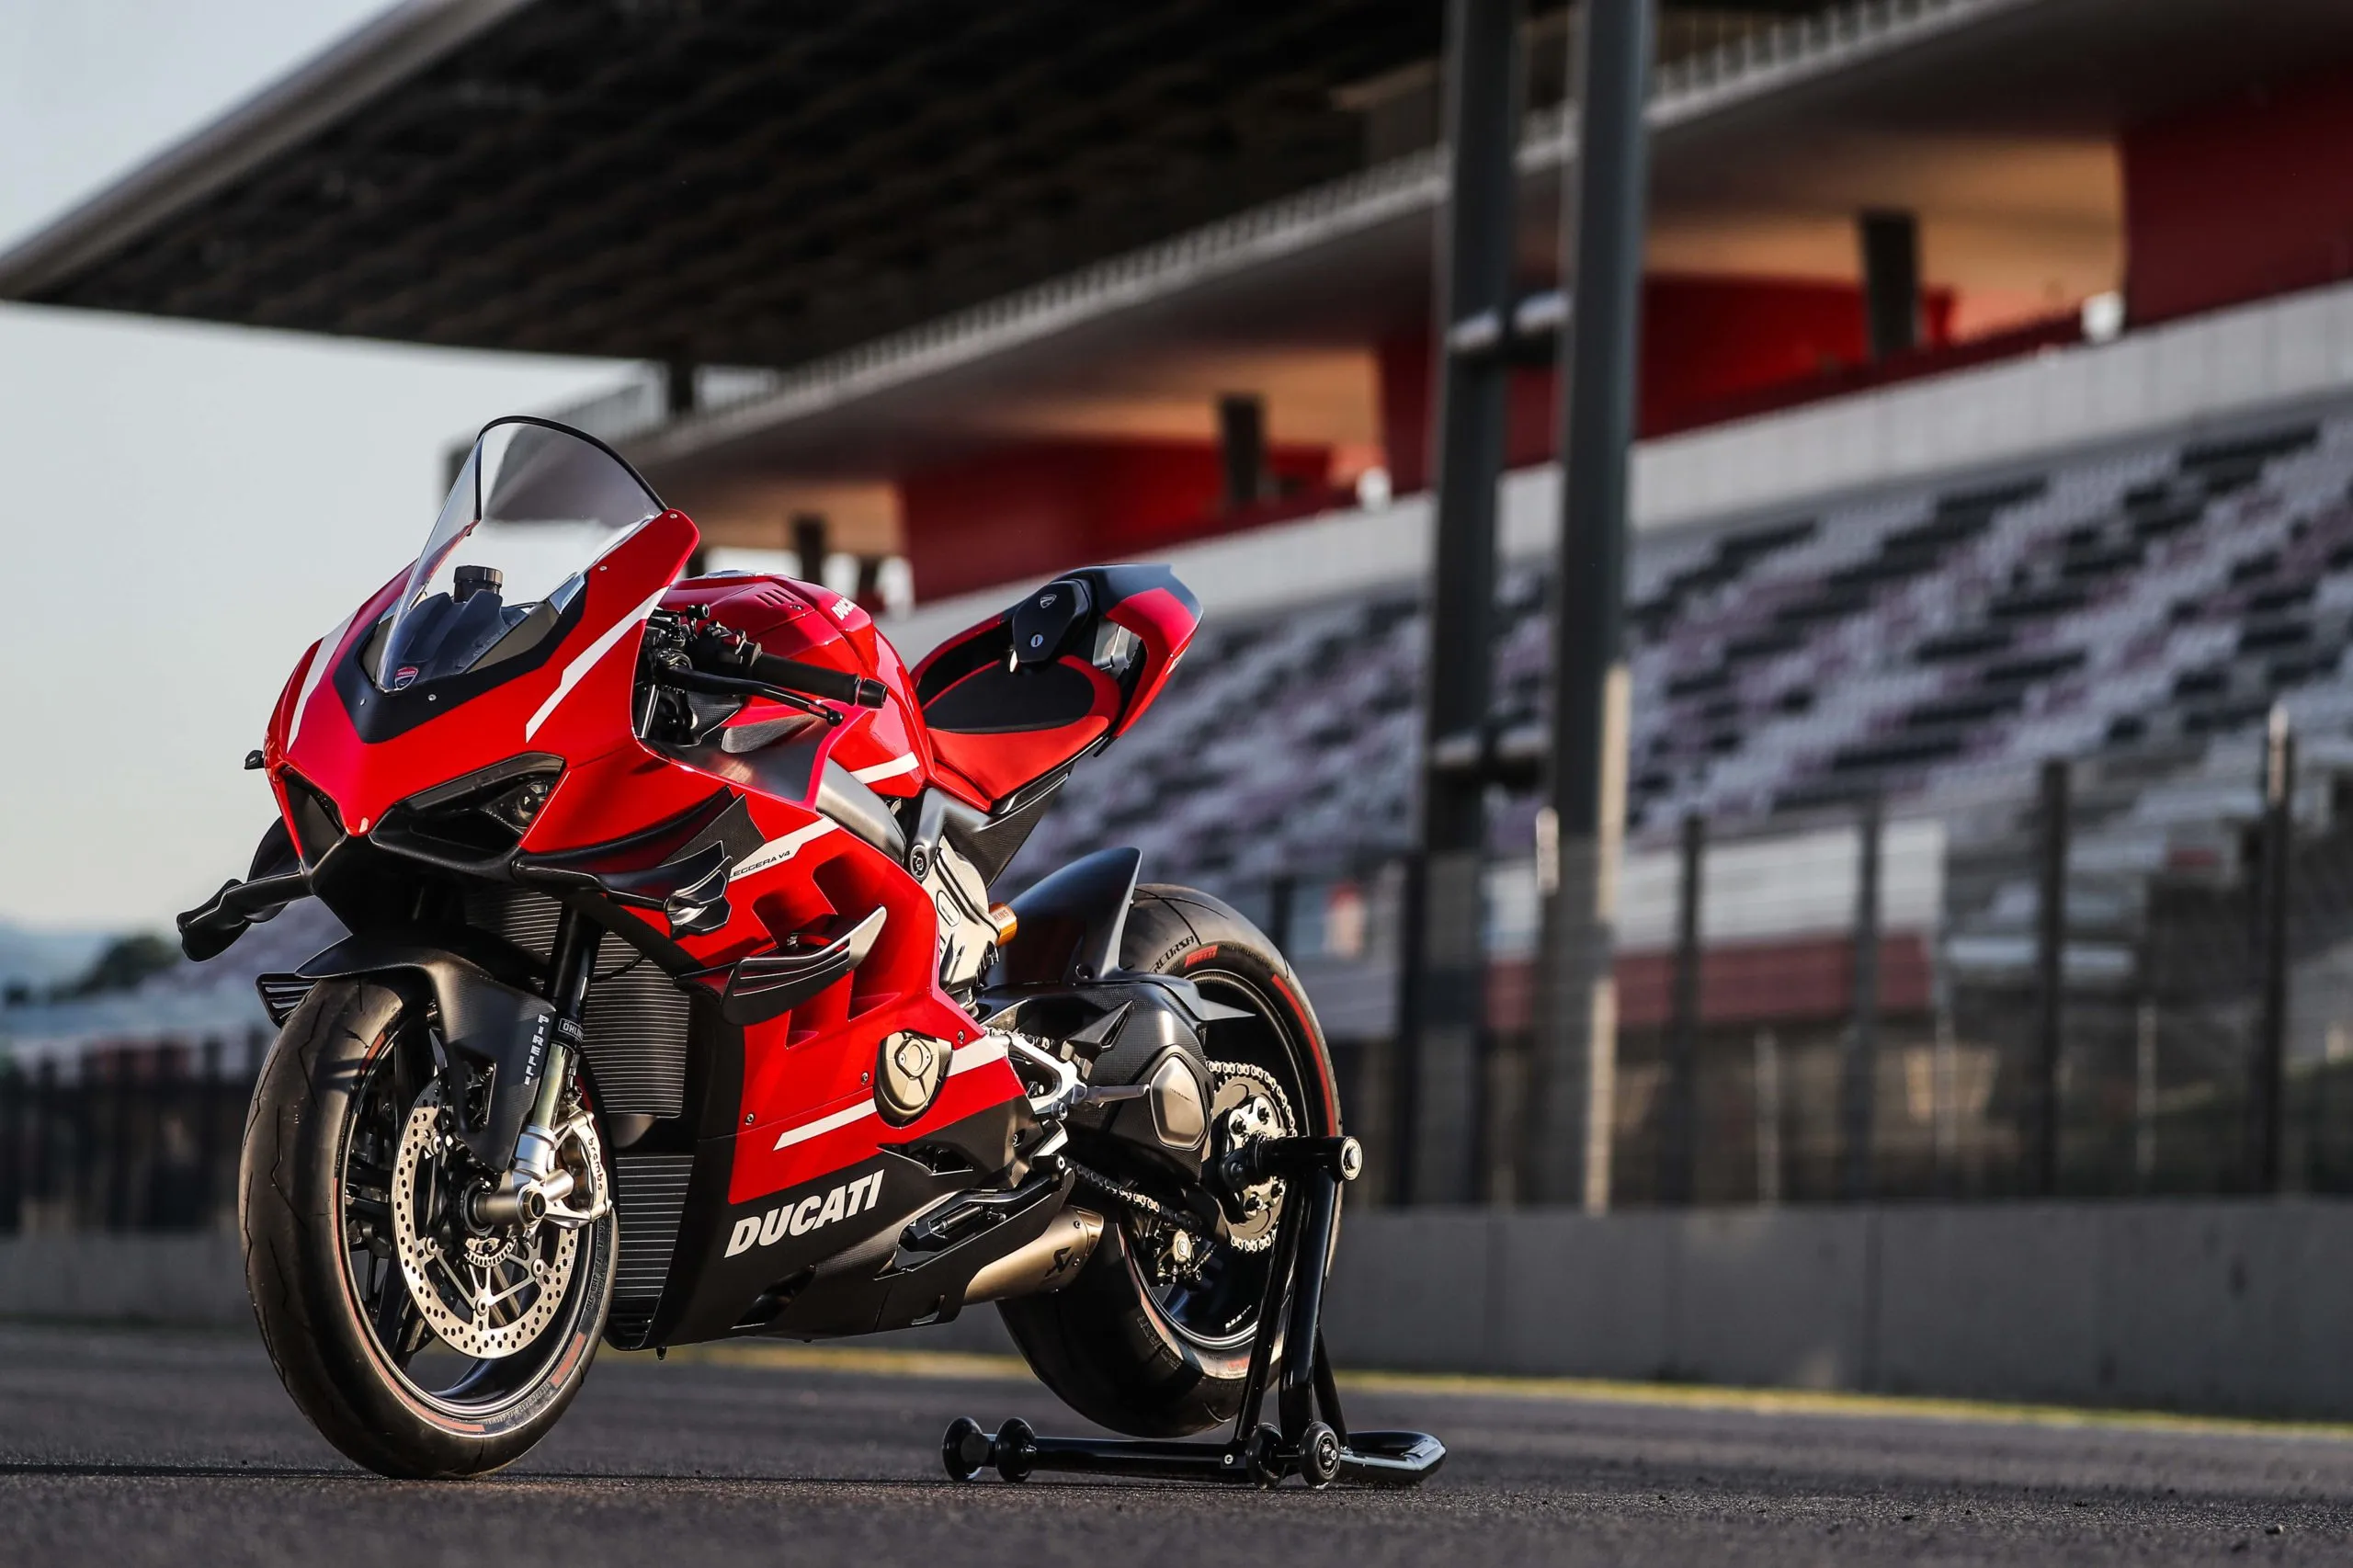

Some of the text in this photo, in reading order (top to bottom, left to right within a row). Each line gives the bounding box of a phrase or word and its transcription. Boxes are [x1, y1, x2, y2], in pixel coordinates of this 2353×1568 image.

[779, 850, 790, 858] V4
[524, 1014, 550, 1085] PIRELLI
[588, 1138, 603, 1190] brembo
[724, 1168, 885, 1258] DUCATI
